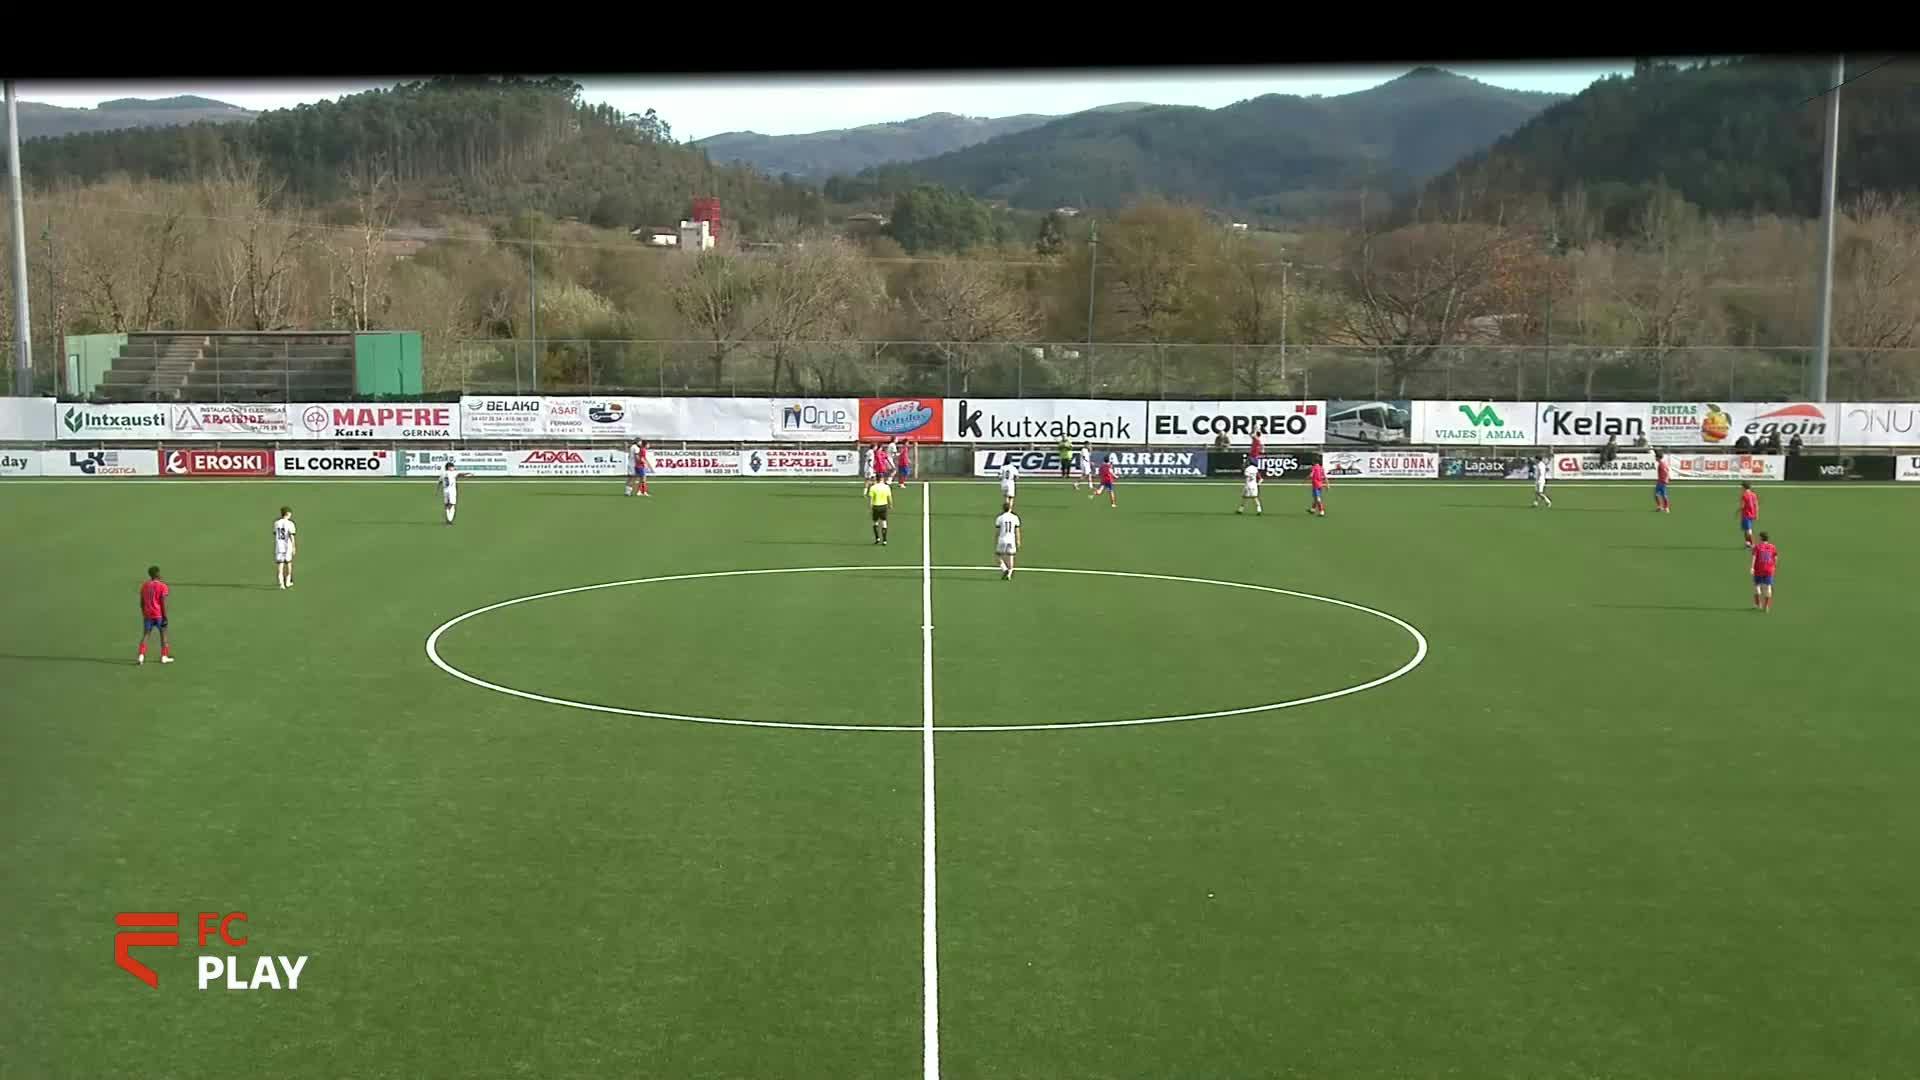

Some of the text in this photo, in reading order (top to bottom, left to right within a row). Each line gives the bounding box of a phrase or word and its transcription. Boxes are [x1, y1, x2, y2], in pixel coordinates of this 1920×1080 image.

[487, 401, 539, 411] BELAKO
[1652, 405, 1696, 414] FRUTAS
[85, 413, 165, 426] Intxausti
[333, 408, 450, 426] MAPFRE
[803, 406, 845, 424] Orue
[1651, 416, 1696, 425] PINILLA
[991, 415, 1130, 439] kutxabank
[1156, 415, 1307, 435] EL CORREO
[1553, 411, 1642, 436] Kelan
[334, 428, 450, 437] Katxi GERNIKA
[1435, 430, 1525, 439] VIAJES AMAIA
[195, 455, 262, 470] EROSKI
[284, 457, 380, 470] EL CORREO
[655, 458, 719, 469] ARGIBIDE
[1109, 452, 1193, 465] ARRIEN
[1369, 458, 1434, 469] ESKU ONAK
[1144, 467, 1202, 475] KLINIKA
[1620, 461, 1656, 471] ABAROA
[1004, 521, 1012, 533] 11
